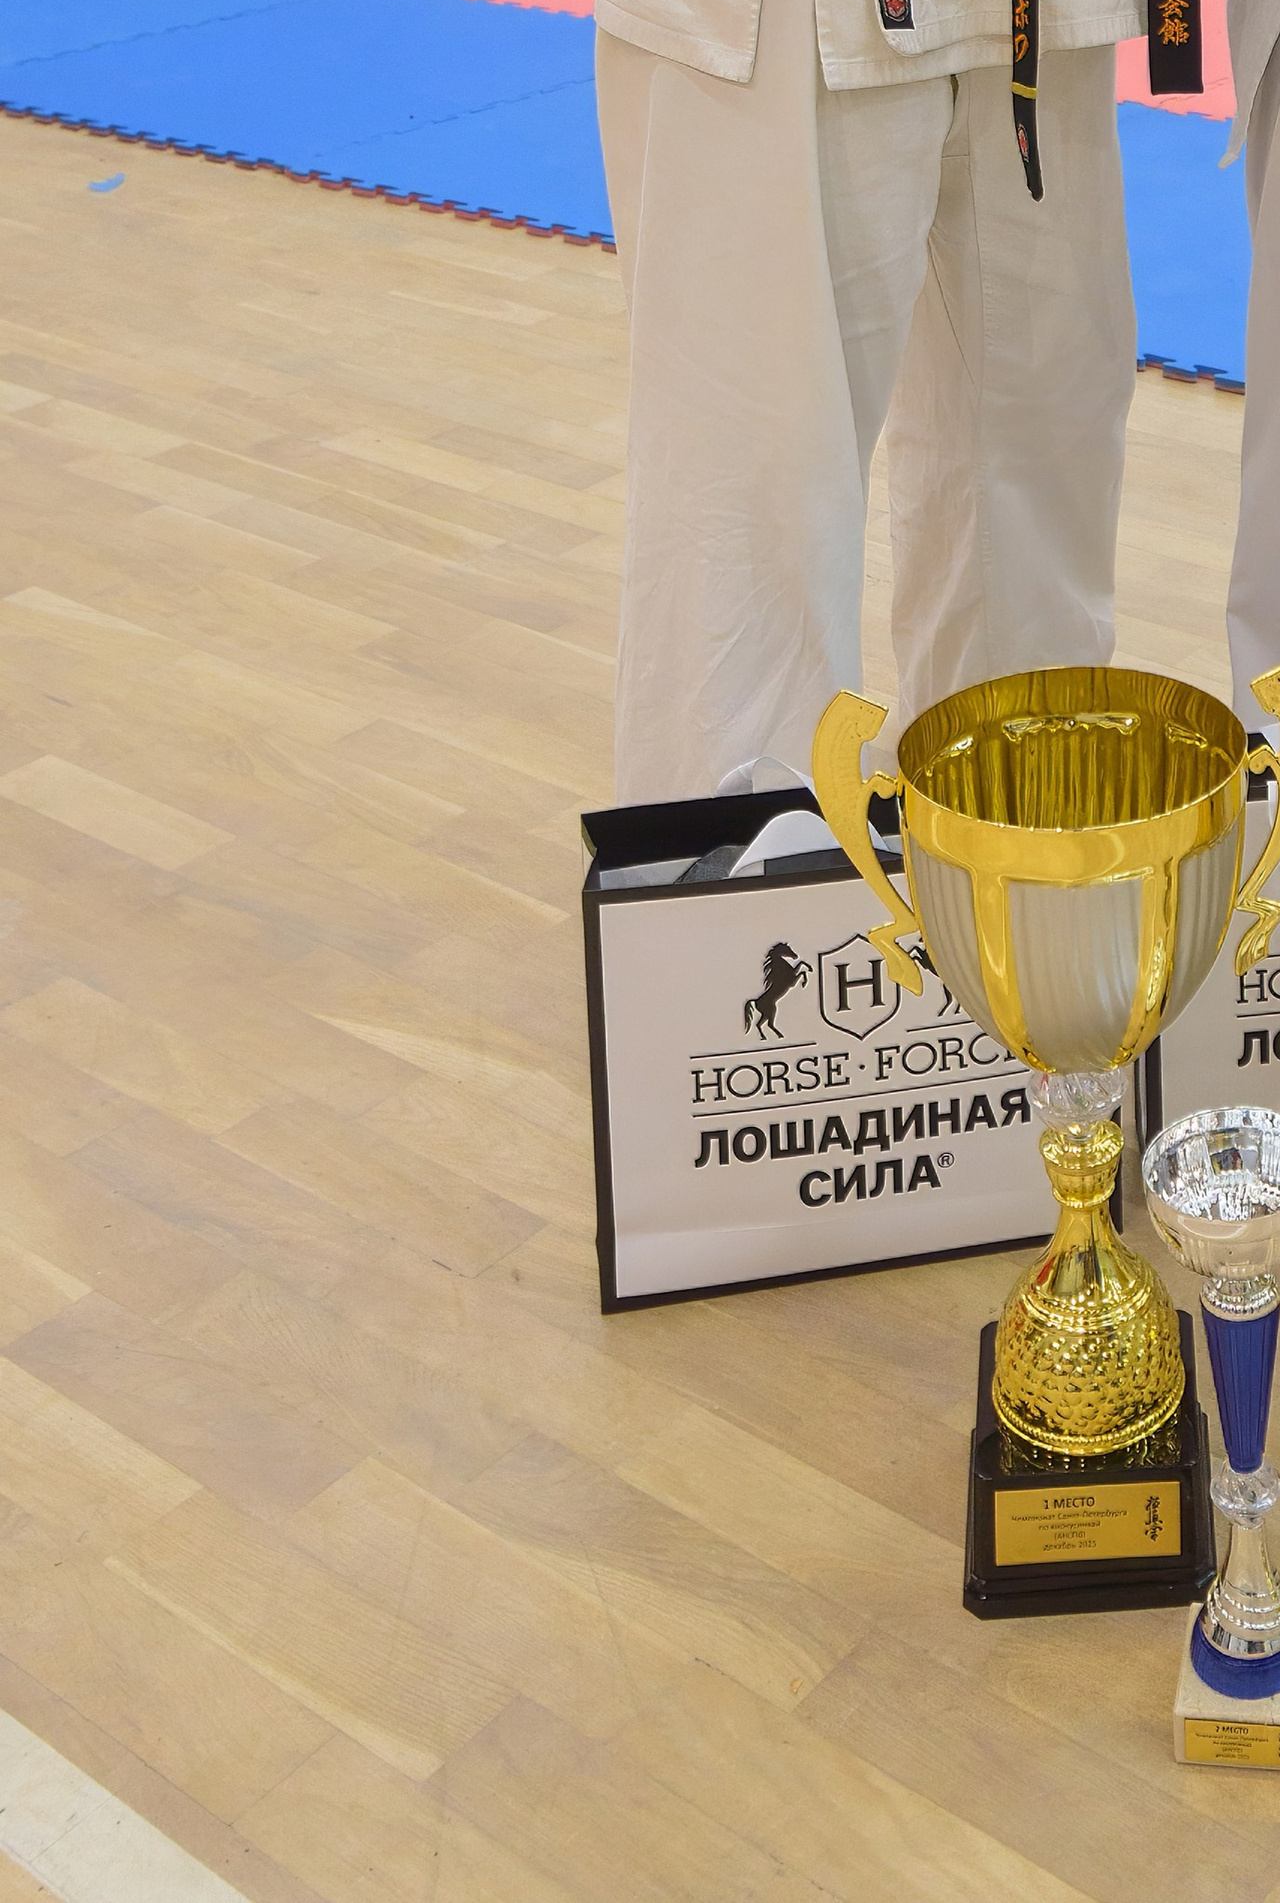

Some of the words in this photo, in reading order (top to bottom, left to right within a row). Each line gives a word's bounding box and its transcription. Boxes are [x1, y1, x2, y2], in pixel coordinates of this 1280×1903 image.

[834, 958, 886, 1013] H
[691, 1052, 851, 1105] HORSE
[694, 1087, 1031, 1169] ЛОШАДИНАЯ
[1053, 1496, 1096, 1509] МЕСТО
